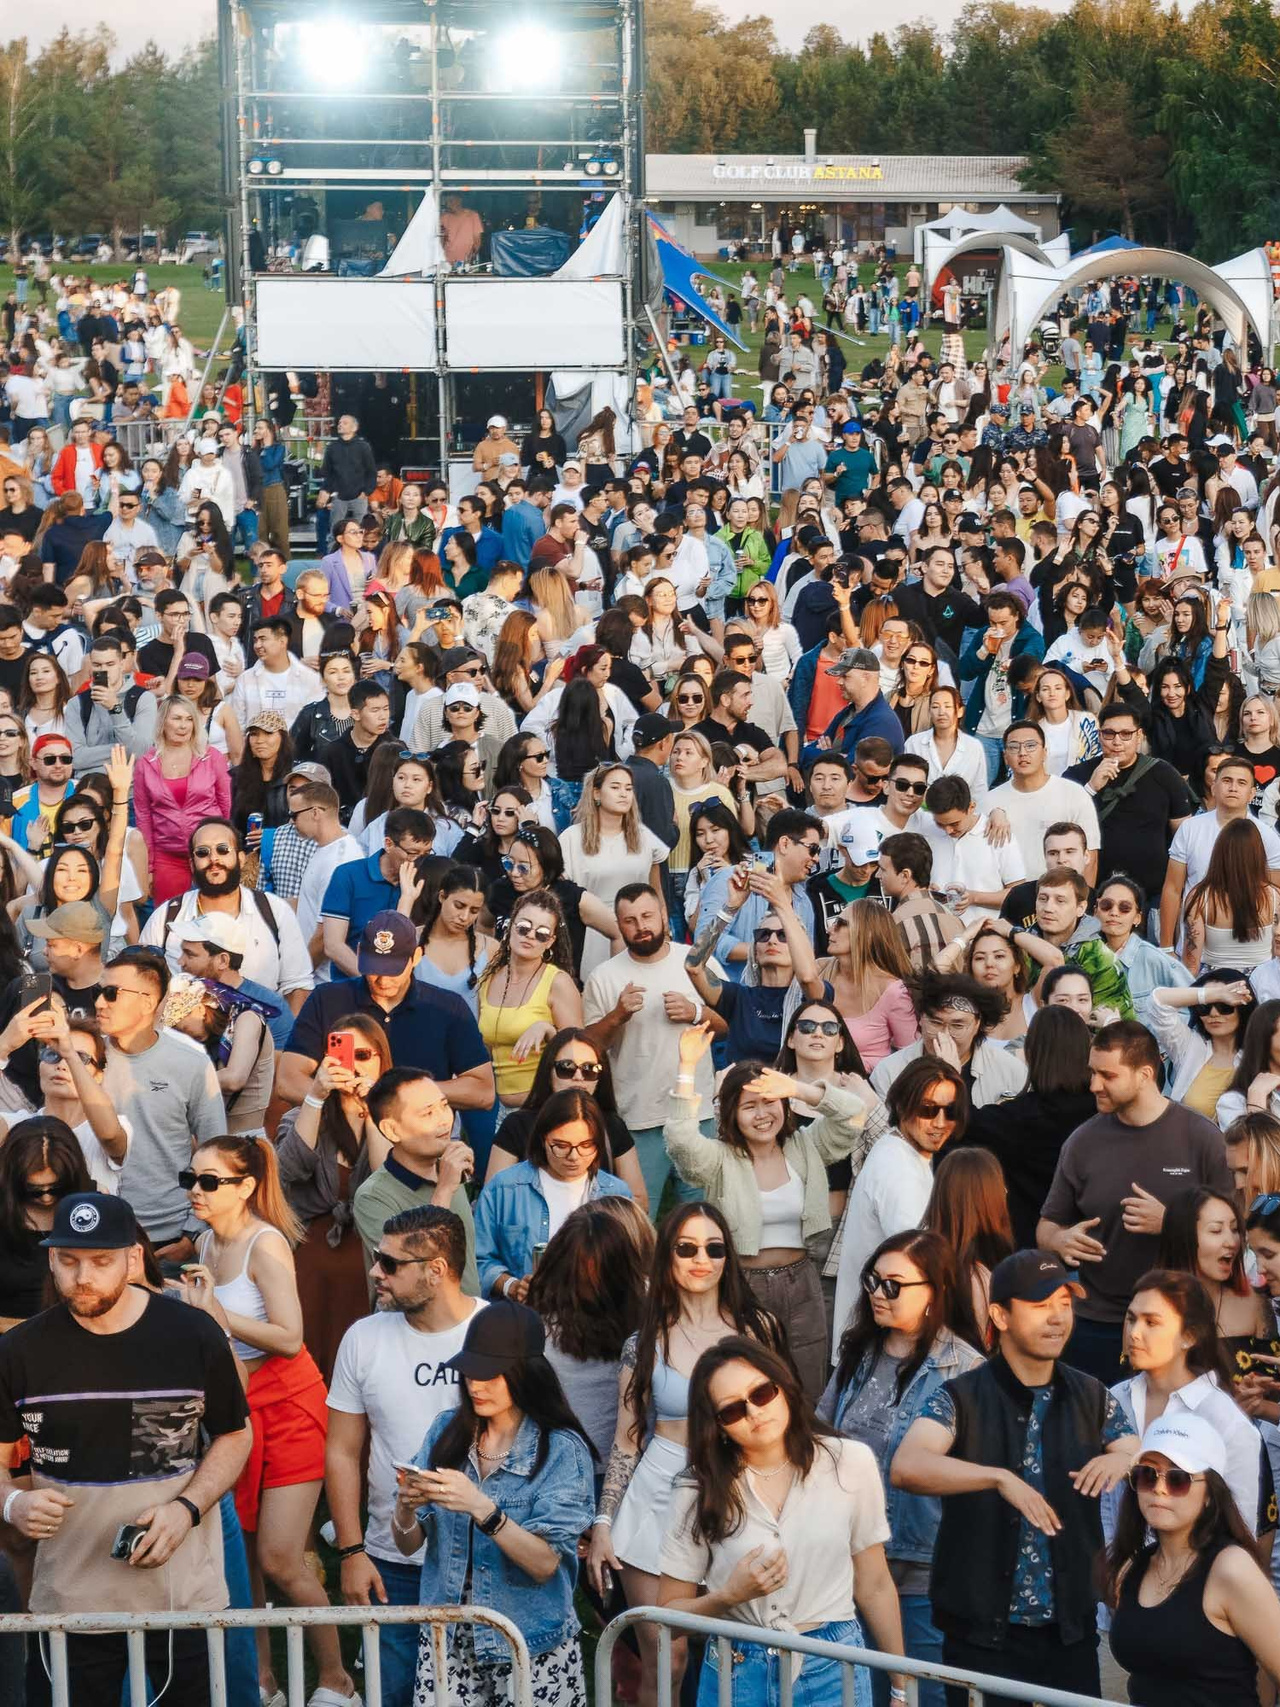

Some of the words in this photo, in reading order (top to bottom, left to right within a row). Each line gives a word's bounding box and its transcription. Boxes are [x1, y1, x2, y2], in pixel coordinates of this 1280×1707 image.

[713, 166, 761, 179] GOLF
[764, 166, 811, 179] CLUB
[813, 166, 884, 179] ASTANA
